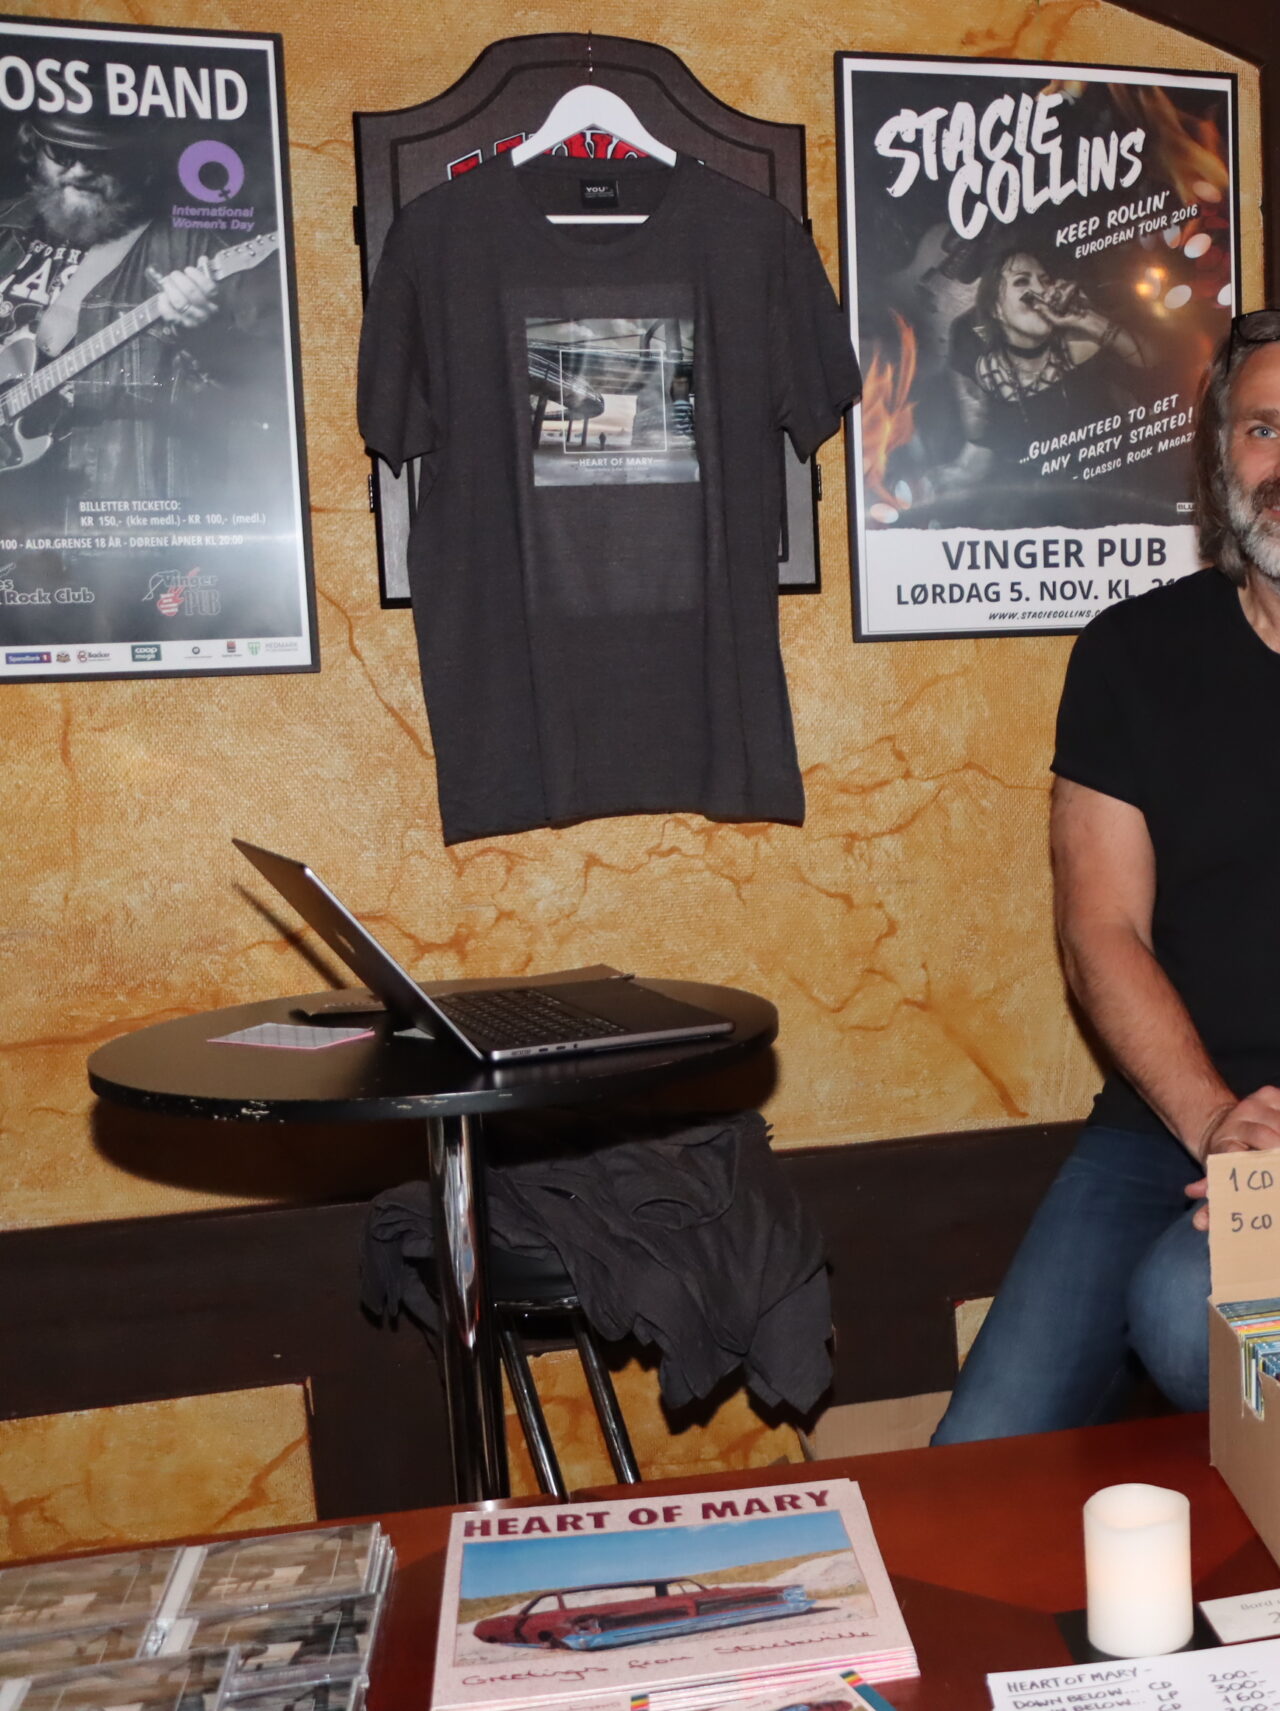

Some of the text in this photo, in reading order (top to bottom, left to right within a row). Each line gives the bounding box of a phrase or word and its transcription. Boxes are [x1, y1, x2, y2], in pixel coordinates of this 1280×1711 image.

[106, 62, 249, 121] BAND
[874, 92, 1064, 197] STACIE
[948, 127, 1146, 240] COLLINS
[172, 204, 255, 218] International
[172, 216, 256, 233] Women's Day
[1055, 190, 1170, 248] KEEP ROLLIN'
[1074, 204, 1198, 259] EUROPEAN TOUR 2016
[1128, 406, 1146, 423] TO
[1153, 393, 1180, 414] GET
[1041, 406, 1194, 476] ANY PARTY STARTED!
[579, 457, 653, 467] HEART OF MARY
[1082, 458, 1122, 480] CLASSIC
[1126, 447, 1153, 465] ROCK
[80, 500, 182, 512] BILLETTER TICKETCO:
[81, 516, 95, 527] KR
[188, 513, 201, 525] KR
[95, 537, 106, 549] 18
[108, 535, 122, 548] ÅR
[129, 536, 169, 548] DØRENE
[170, 534, 203, 547] ÅPNER
[205, 535, 217, 546] KL
[941, 538, 1168, 571] VINGER PUB
[5, 586, 95, 605] Rock Club
[896, 580, 1001, 606] LØRDAG
[1009, 580, 1030, 602] 5.
[1039, 579, 1099, 601] NOV.
[1228, 1167, 1240, 1192] 1
[1247, 1169, 1274, 1191] CD
[1230, 1211, 1244, 1232] 5
[1250, 1212, 1273, 1230] CD
[462, 1489, 830, 1538] HEART OF MARY
[1006, 1677, 1060, 1693] HEART
[1064, 1673, 1087, 1685] OF
[1090, 1667, 1138, 1682] MARY
[1012, 1696, 1062, 1710] DOWN
[1149, 1680, 1173, 1690] CD
[1157, 1689, 1179, 1702] LP
